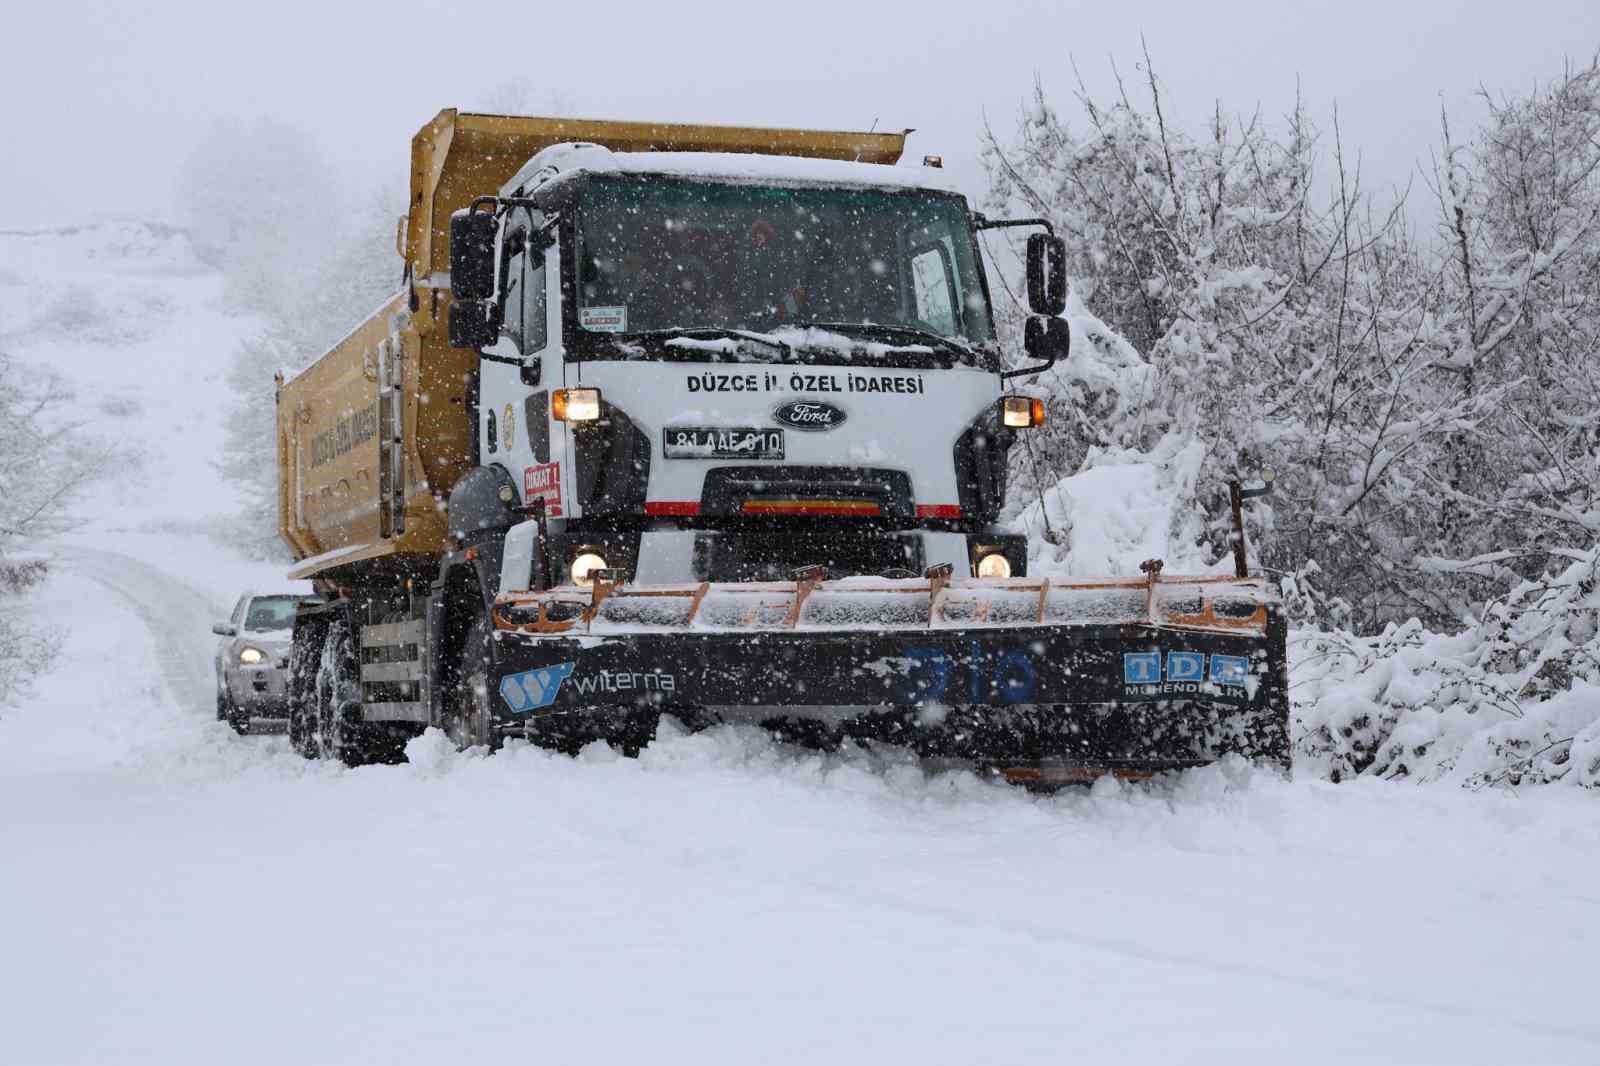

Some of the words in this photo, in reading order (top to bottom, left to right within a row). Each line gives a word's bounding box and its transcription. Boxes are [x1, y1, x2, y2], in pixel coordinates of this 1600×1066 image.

[687, 371, 759, 393] DÜZCE
[790, 372, 842, 392] ÖZEL
[848, 373, 924, 395] İDARESİ
[790, 404, 832, 423] Ford
[676, 431, 697, 448] 81
[573, 670, 676, 695] witerna
